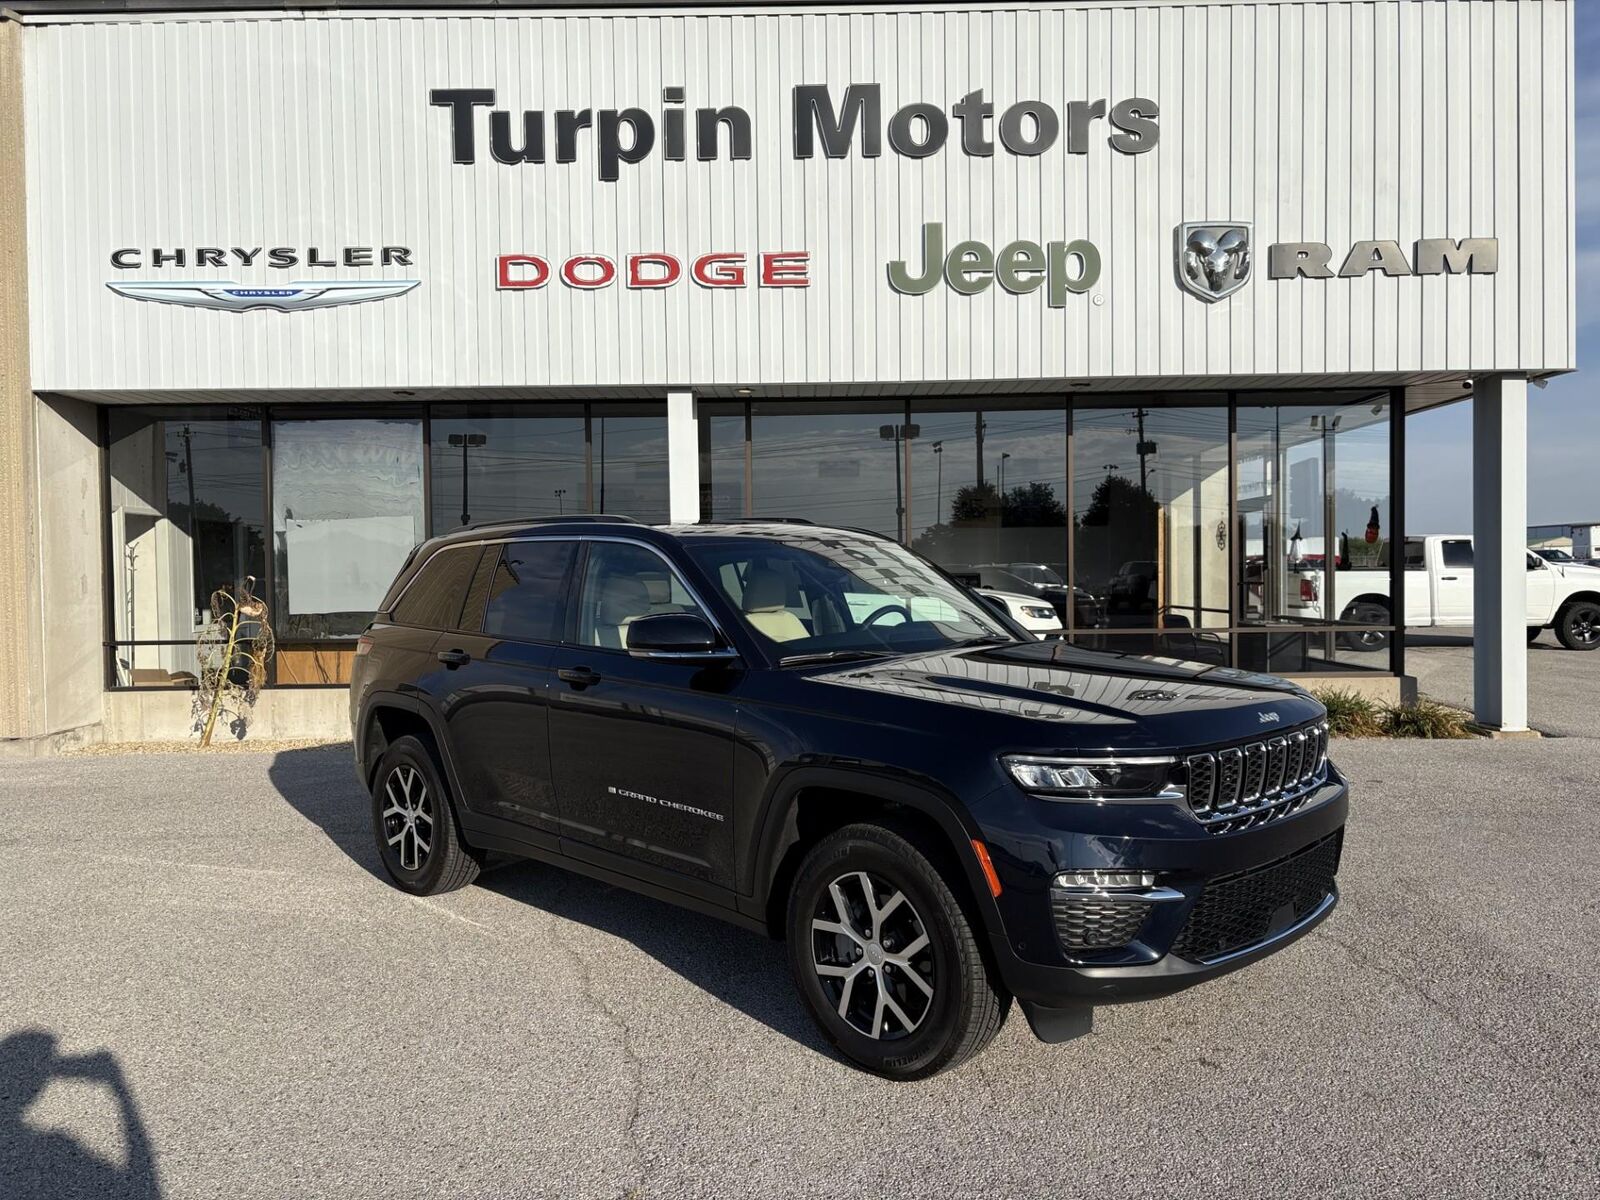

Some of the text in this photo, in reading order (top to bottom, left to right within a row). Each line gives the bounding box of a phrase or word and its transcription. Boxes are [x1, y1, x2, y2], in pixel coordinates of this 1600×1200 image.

[430, 83, 1161, 182] Turpin Motors
[110, 246, 414, 269] CHRYSLER
[495, 250, 810, 290] DODGE
[887, 222, 1102, 308] Jeep
[1268, 237, 1498, 280] RAM
[618, 788, 725, 822] GRAND CHEROKEE
